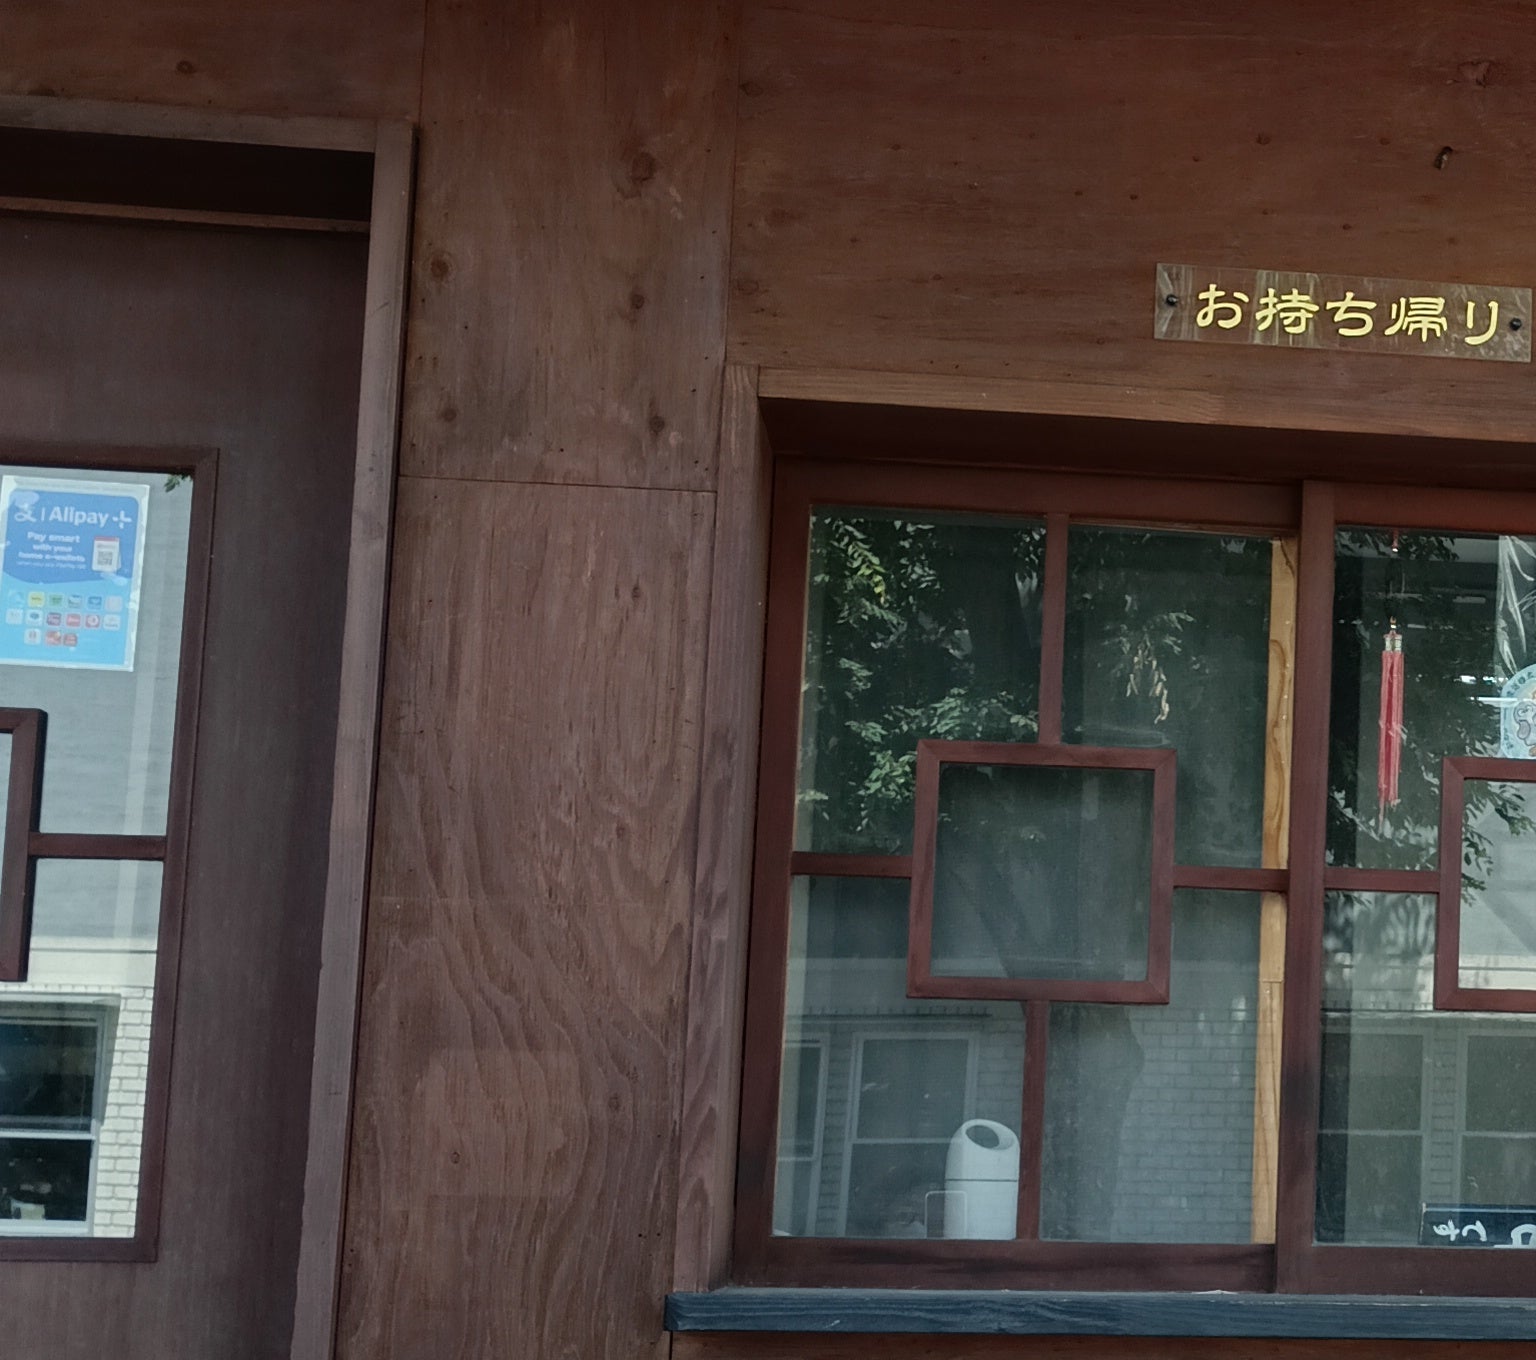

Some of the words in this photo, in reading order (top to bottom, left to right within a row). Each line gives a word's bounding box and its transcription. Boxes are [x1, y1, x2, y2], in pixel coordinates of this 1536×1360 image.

[1194, 282, 1500, 347] お持ち帰り
